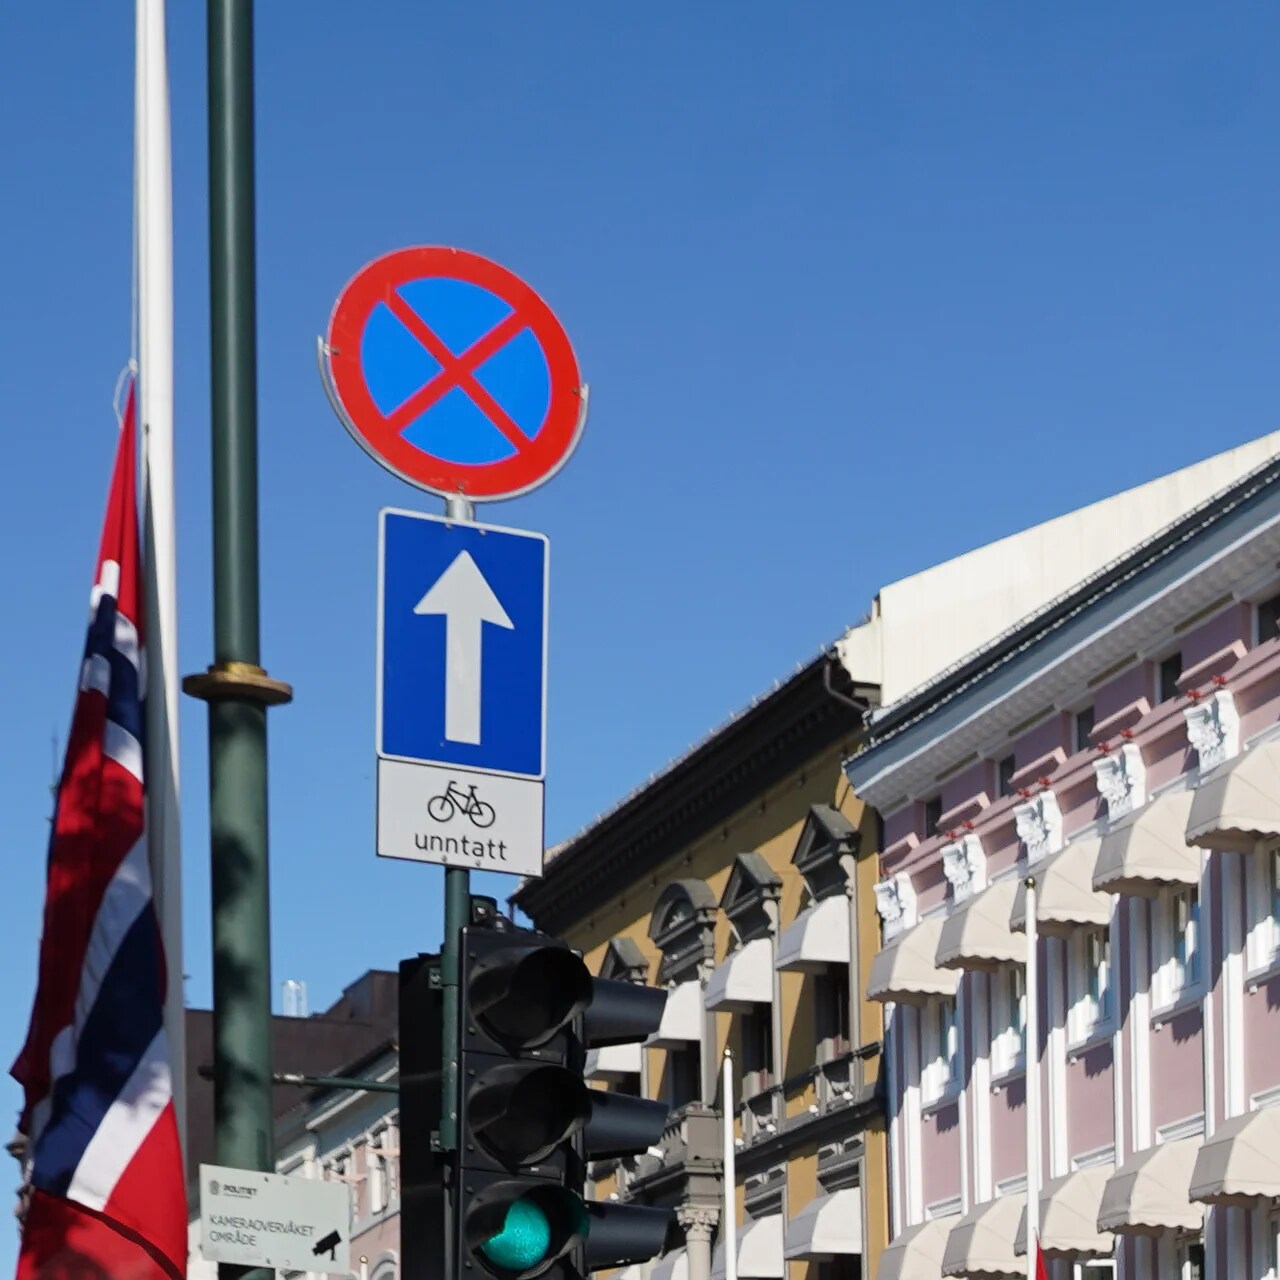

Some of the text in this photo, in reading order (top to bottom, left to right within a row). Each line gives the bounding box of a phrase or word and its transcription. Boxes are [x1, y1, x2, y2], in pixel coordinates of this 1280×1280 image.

[414, 832, 508, 861] unntatt
[209, 1213, 316, 1237] KAMERAOVERVÅKET
[209, 1230, 256, 1247] OMRÅDE
